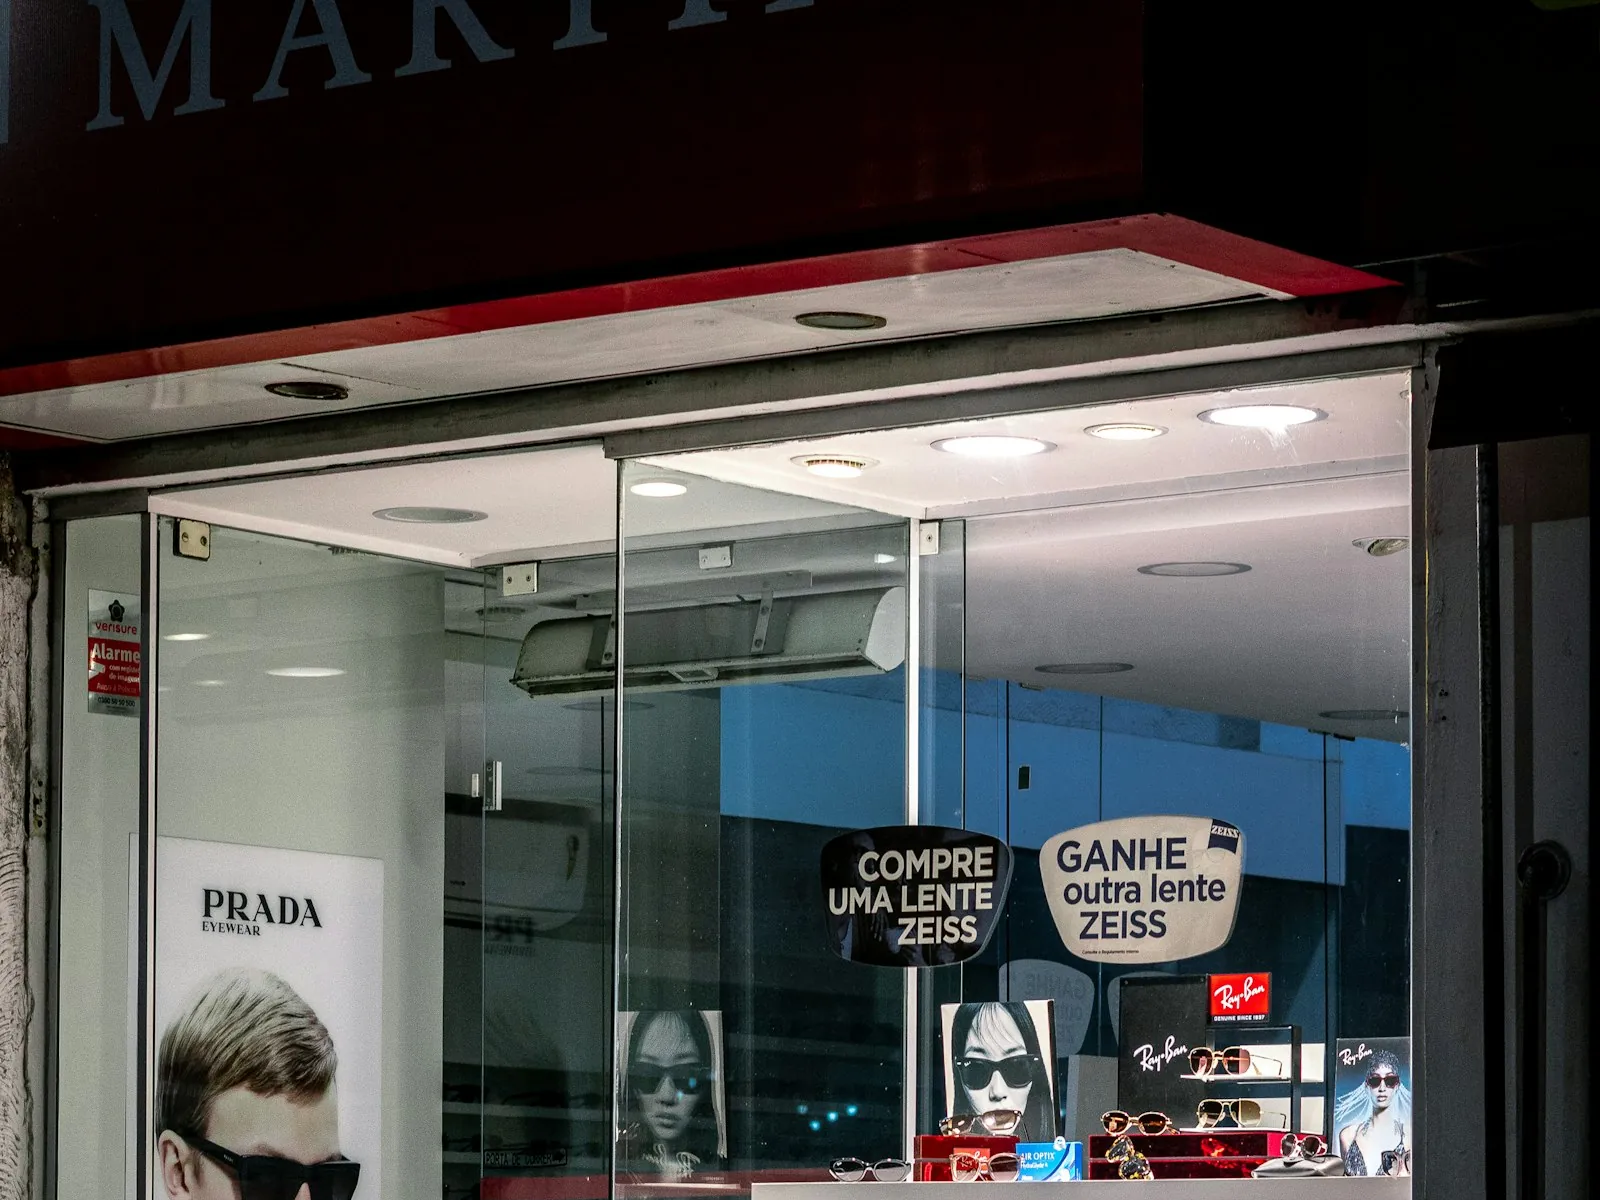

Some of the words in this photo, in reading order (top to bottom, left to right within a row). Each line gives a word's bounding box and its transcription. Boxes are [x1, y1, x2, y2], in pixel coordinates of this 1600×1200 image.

[96, 622, 137, 635] verisure
[93, 643, 140, 663] Alarme
[1211, 825, 1240, 838] ZEISS
[858, 846, 994, 882] COMPRE
[1057, 837, 1187, 873] GANHE
[828, 885, 893, 915] UMA
[901, 882, 993, 913] LENTE
[1063, 877, 1141, 905] outra
[1151, 873, 1226, 903] lente
[202, 888, 323, 928] PRADA
[202, 921, 261, 936] EYEWEAR
[898, 915, 977, 945] ZEISS
[1079, 910, 1167, 940] ZEISS
[1033, 1152, 1055, 1160] OPTIX
